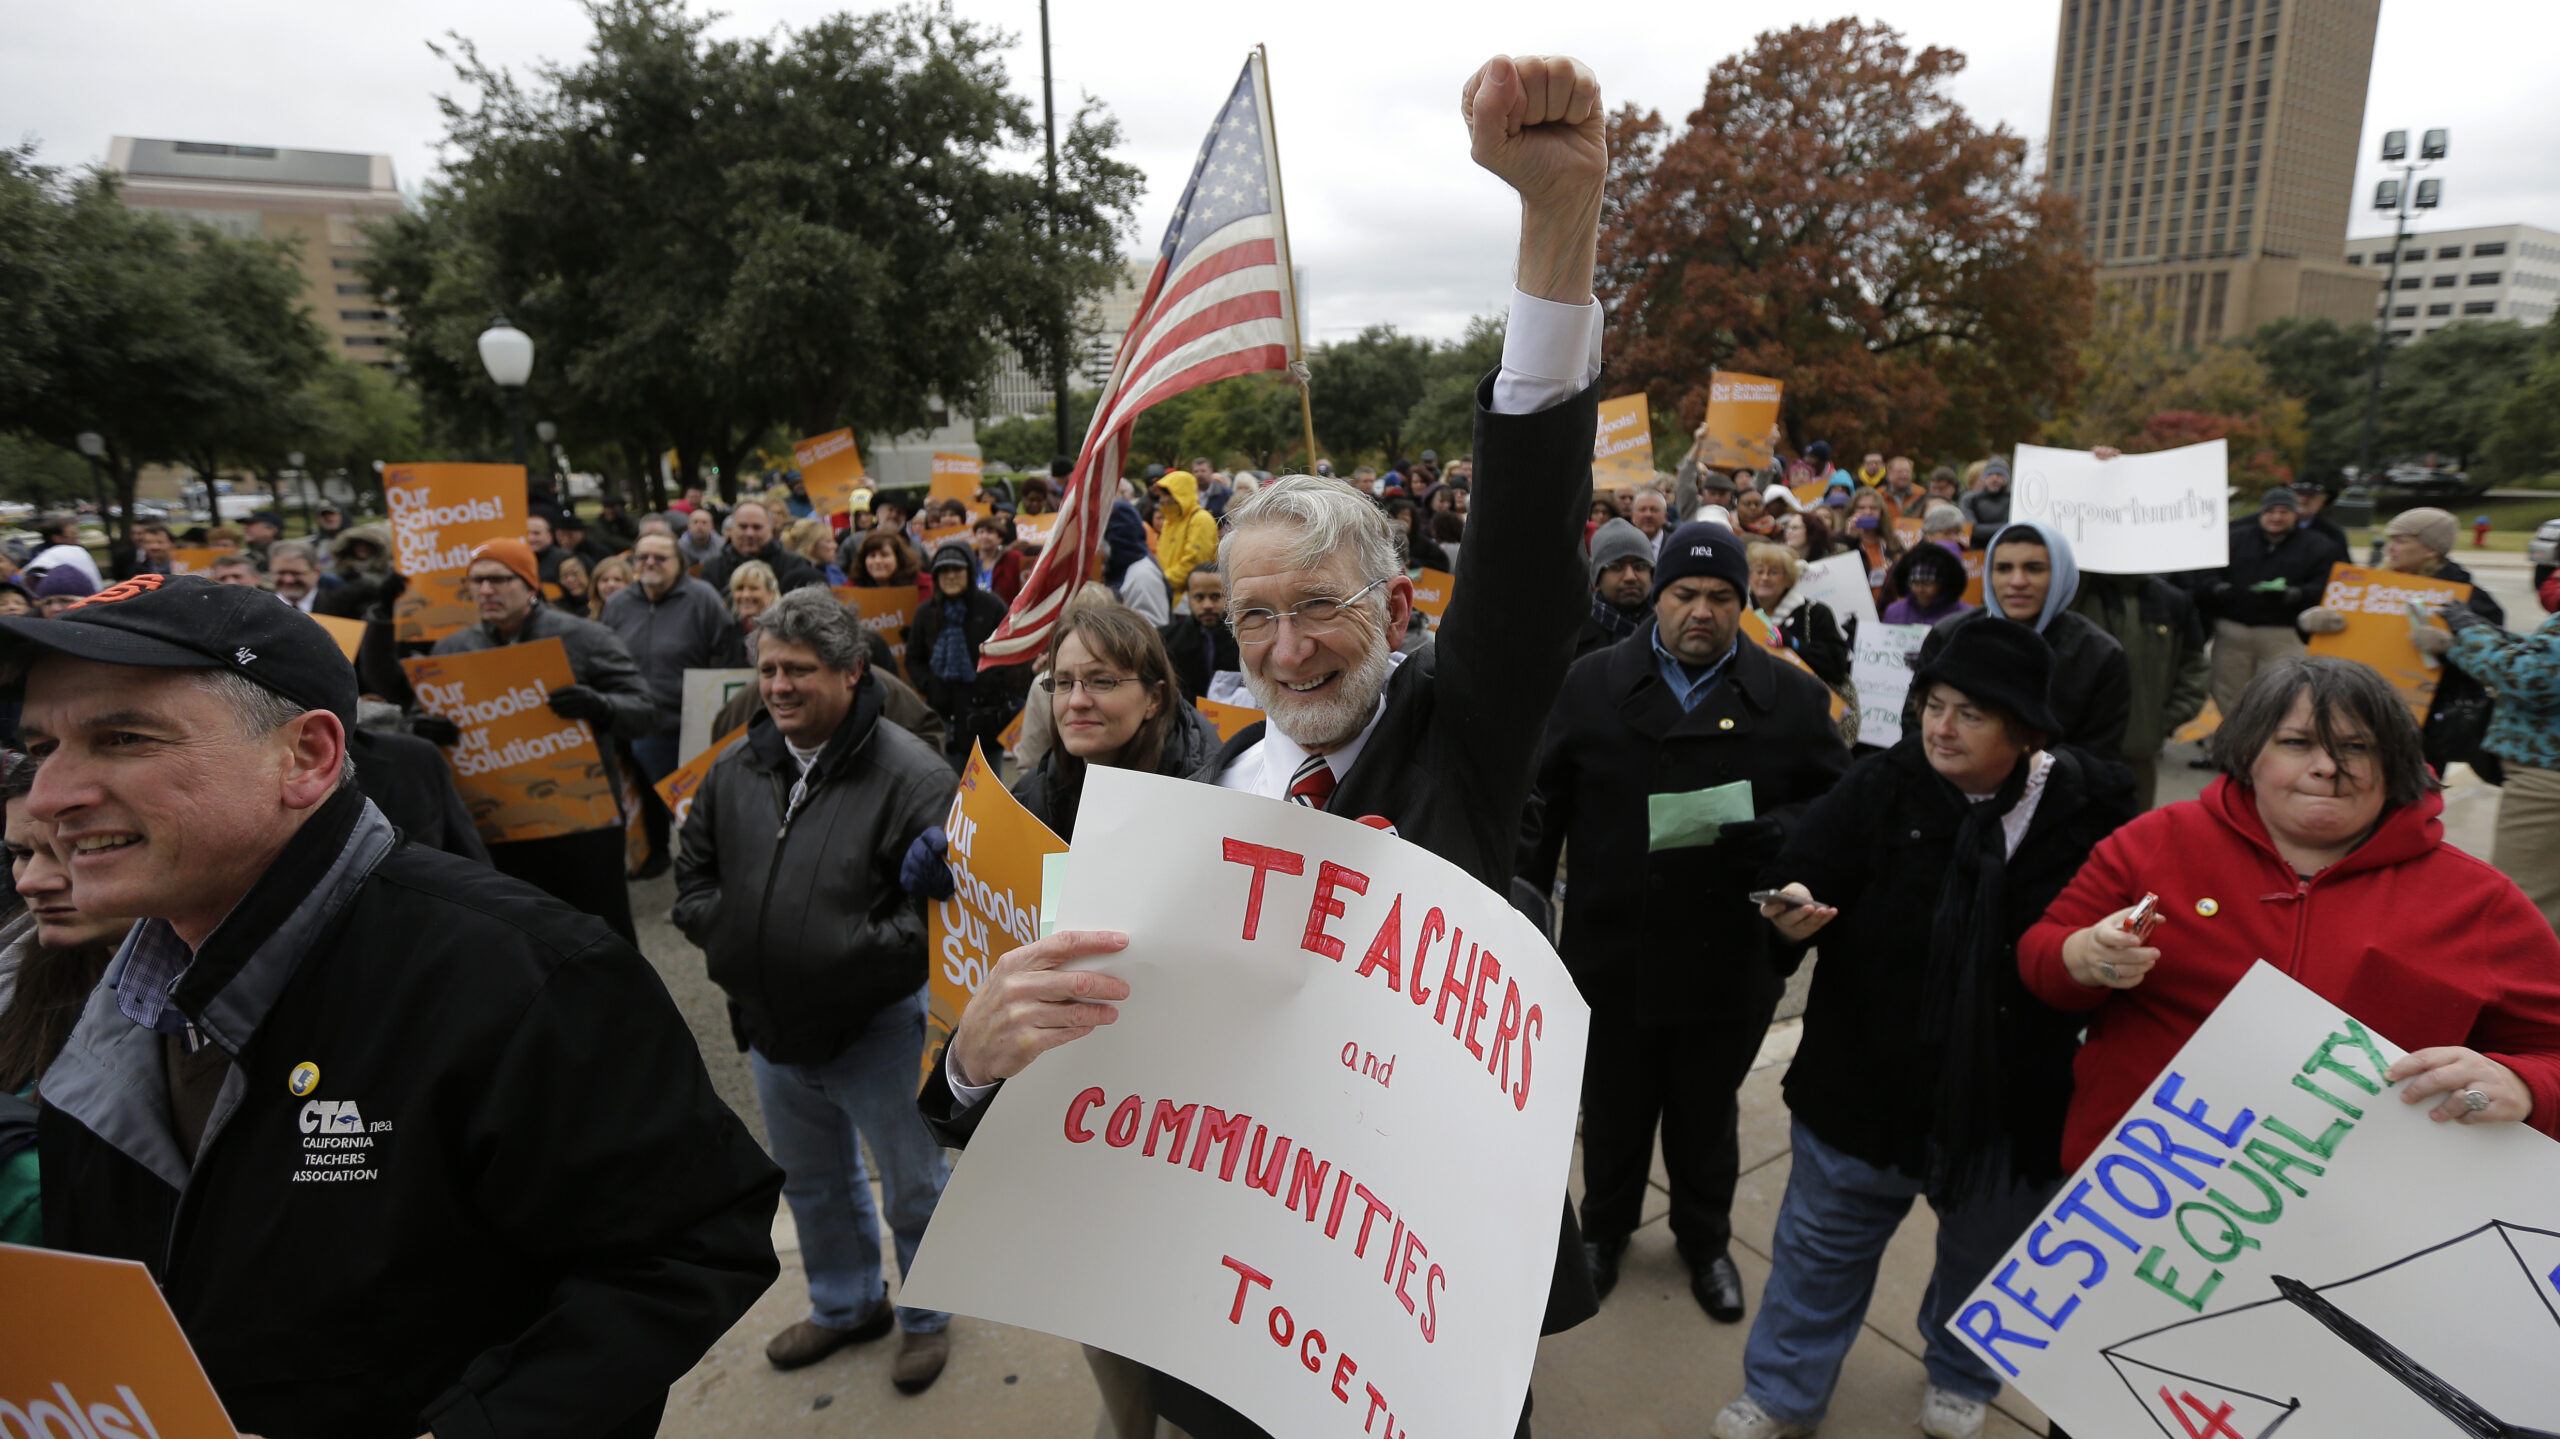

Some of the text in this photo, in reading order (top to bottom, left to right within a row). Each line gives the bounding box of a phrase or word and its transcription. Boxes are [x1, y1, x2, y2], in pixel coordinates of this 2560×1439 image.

[387, 487, 430, 511] Our
[393, 496, 504, 533] Schools!
[397, 530, 439, 551] Our
[415, 680, 464, 709] Our
[452, 718, 592, 776] Solutions!
[453, 727, 489, 752] ur
[946, 791, 977, 858] Our
[947, 858, 1040, 946] chools!
[940, 894, 989, 955] Our
[1222, 837, 1543, 1112] TEACHERS
[1341, 1041, 1395, 1089] and
[299, 1099, 393, 1134] CTA nea
[302, 1136, 375, 1149] CALIFORNIA
[304, 1153, 366, 1166] TEACHERS
[292, 1169, 379, 1182] ASSOCIATION
[2134, 1018, 2395, 1314] EQUALITY
[1064, 1086, 1446, 1344] COMMUNITIES
[1956, 1071, 2256, 1377] RESTORE
